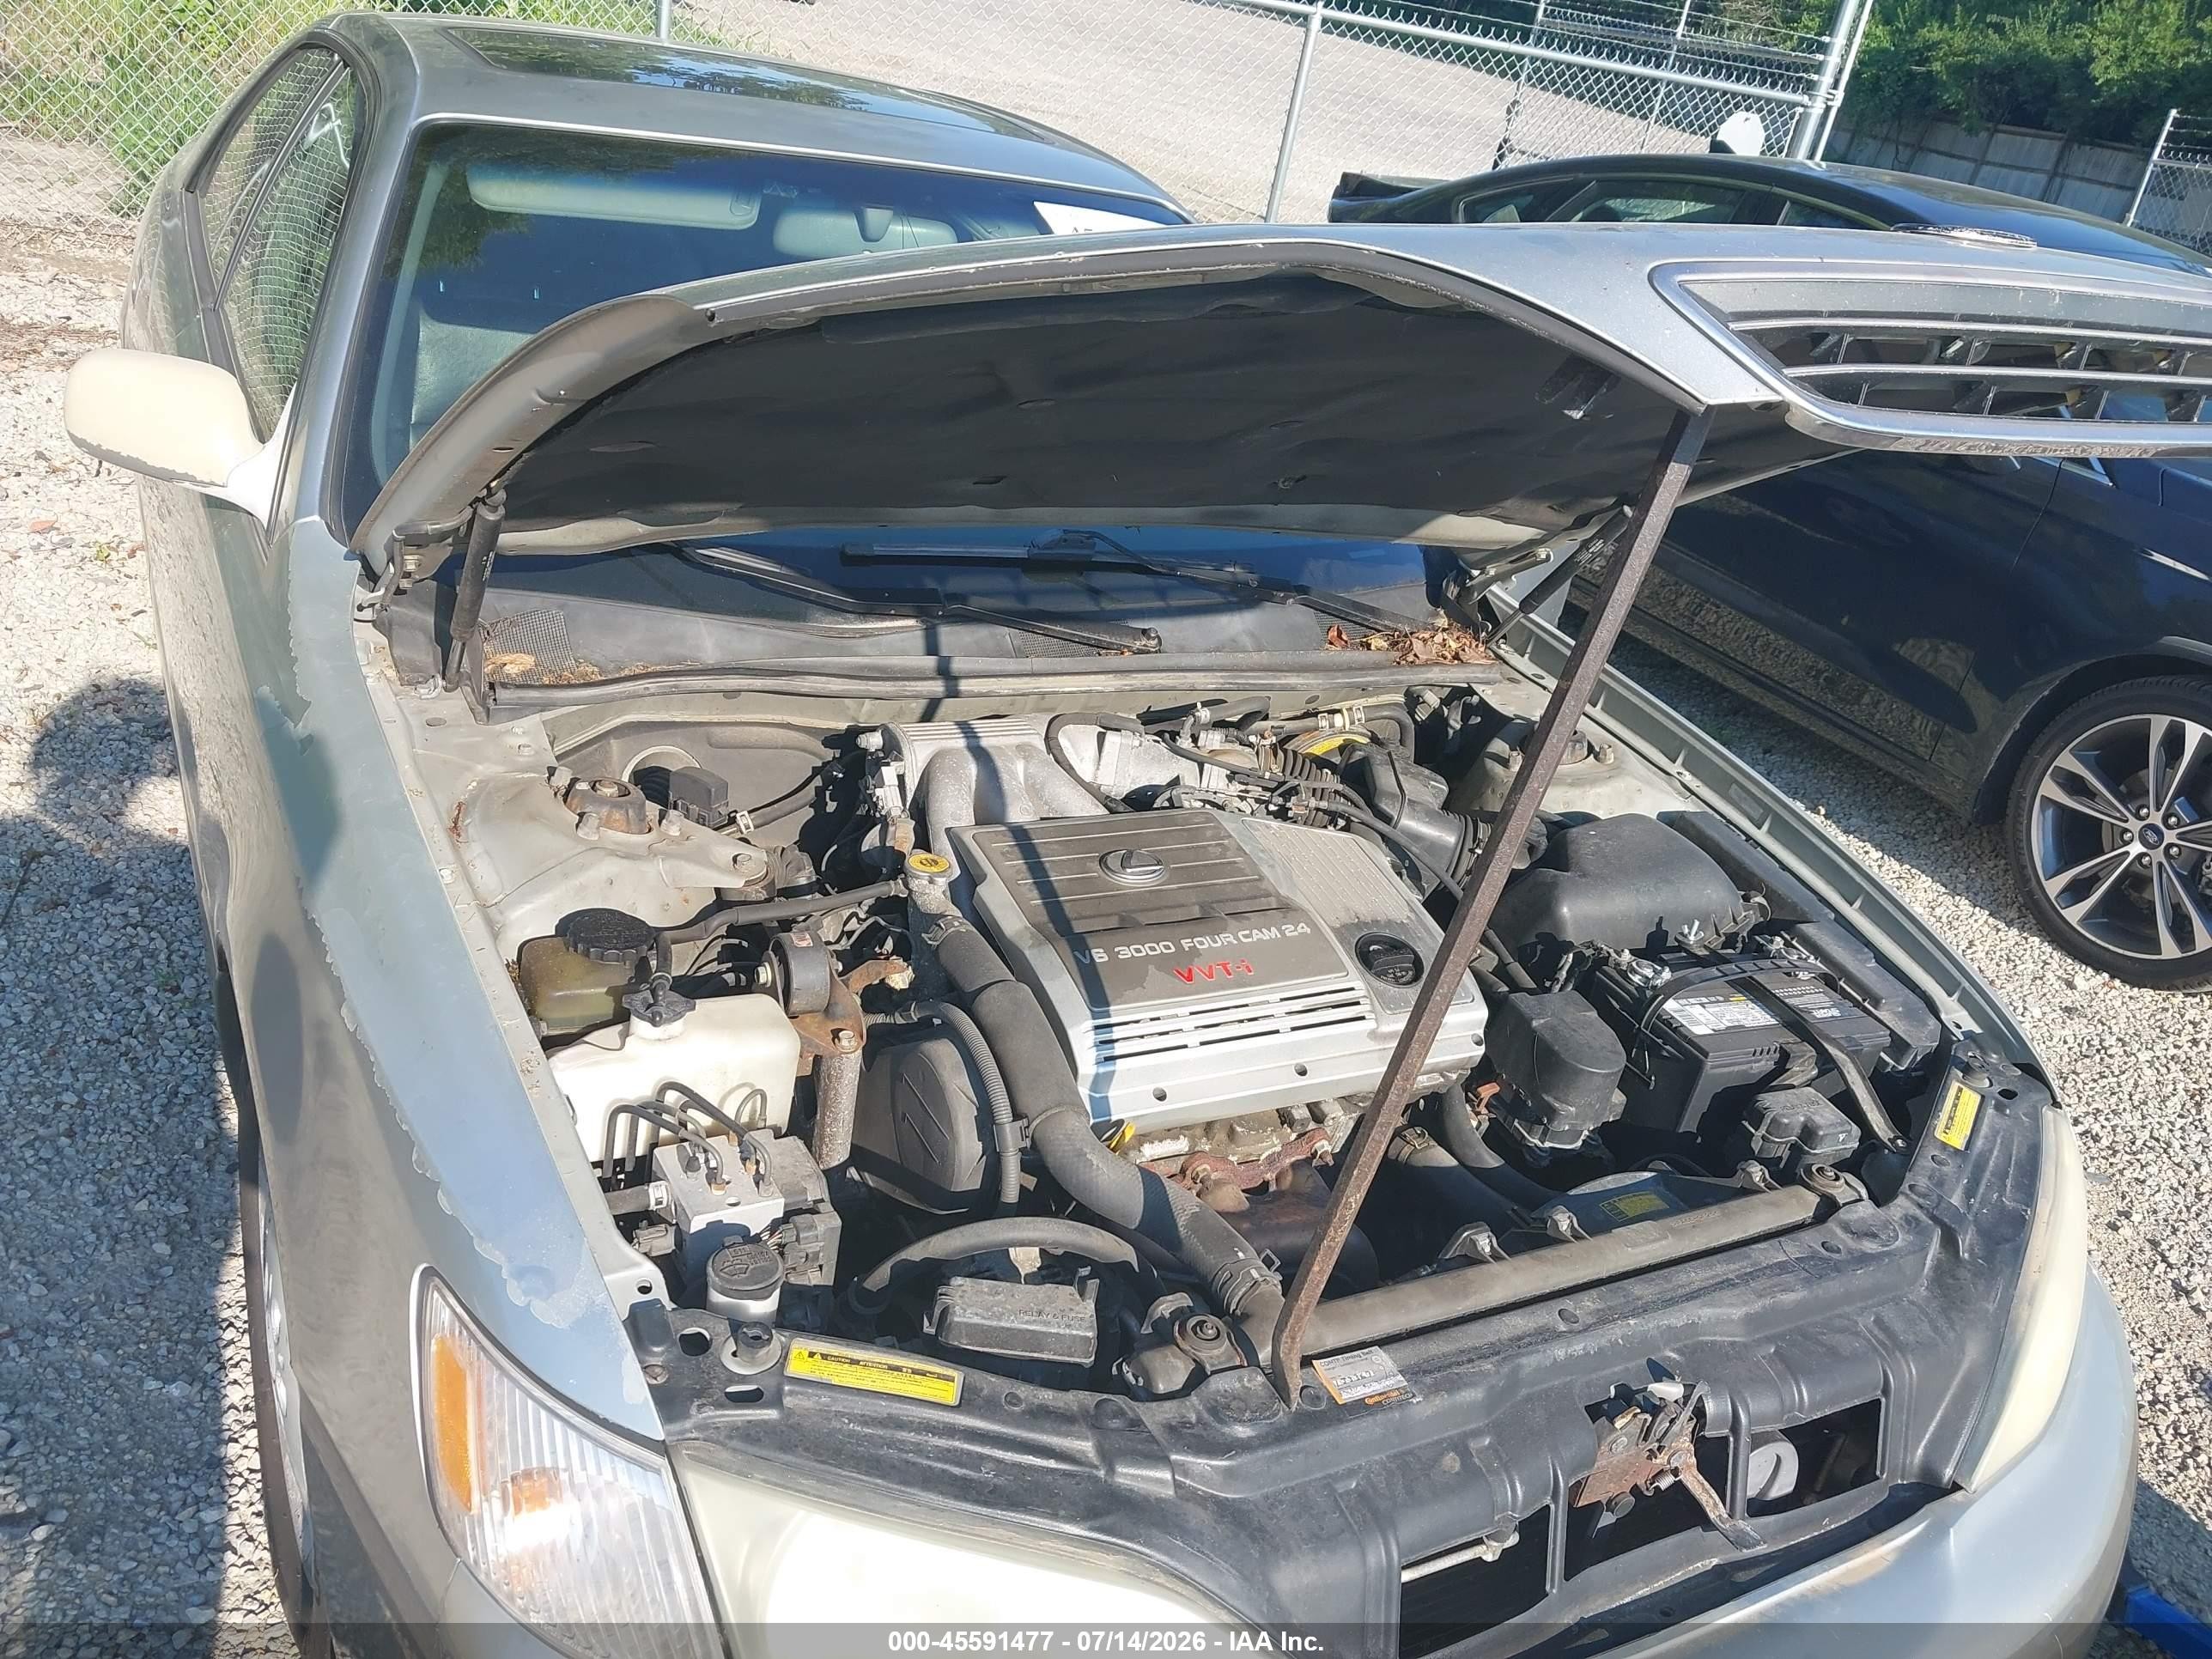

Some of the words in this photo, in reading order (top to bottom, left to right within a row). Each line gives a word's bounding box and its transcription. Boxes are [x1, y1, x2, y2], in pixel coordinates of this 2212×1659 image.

[1074, 948, 1109, 964] V6
[1115, 941, 1175, 959] 3000
[1181, 932, 1237, 951] FOUR
[1238, 927, 1281, 943] CAM
[1284, 921, 1311, 937] 24
[1173, 958, 1254, 985] VVT-i
[1018, 1310, 1049, 1319] RELAY
